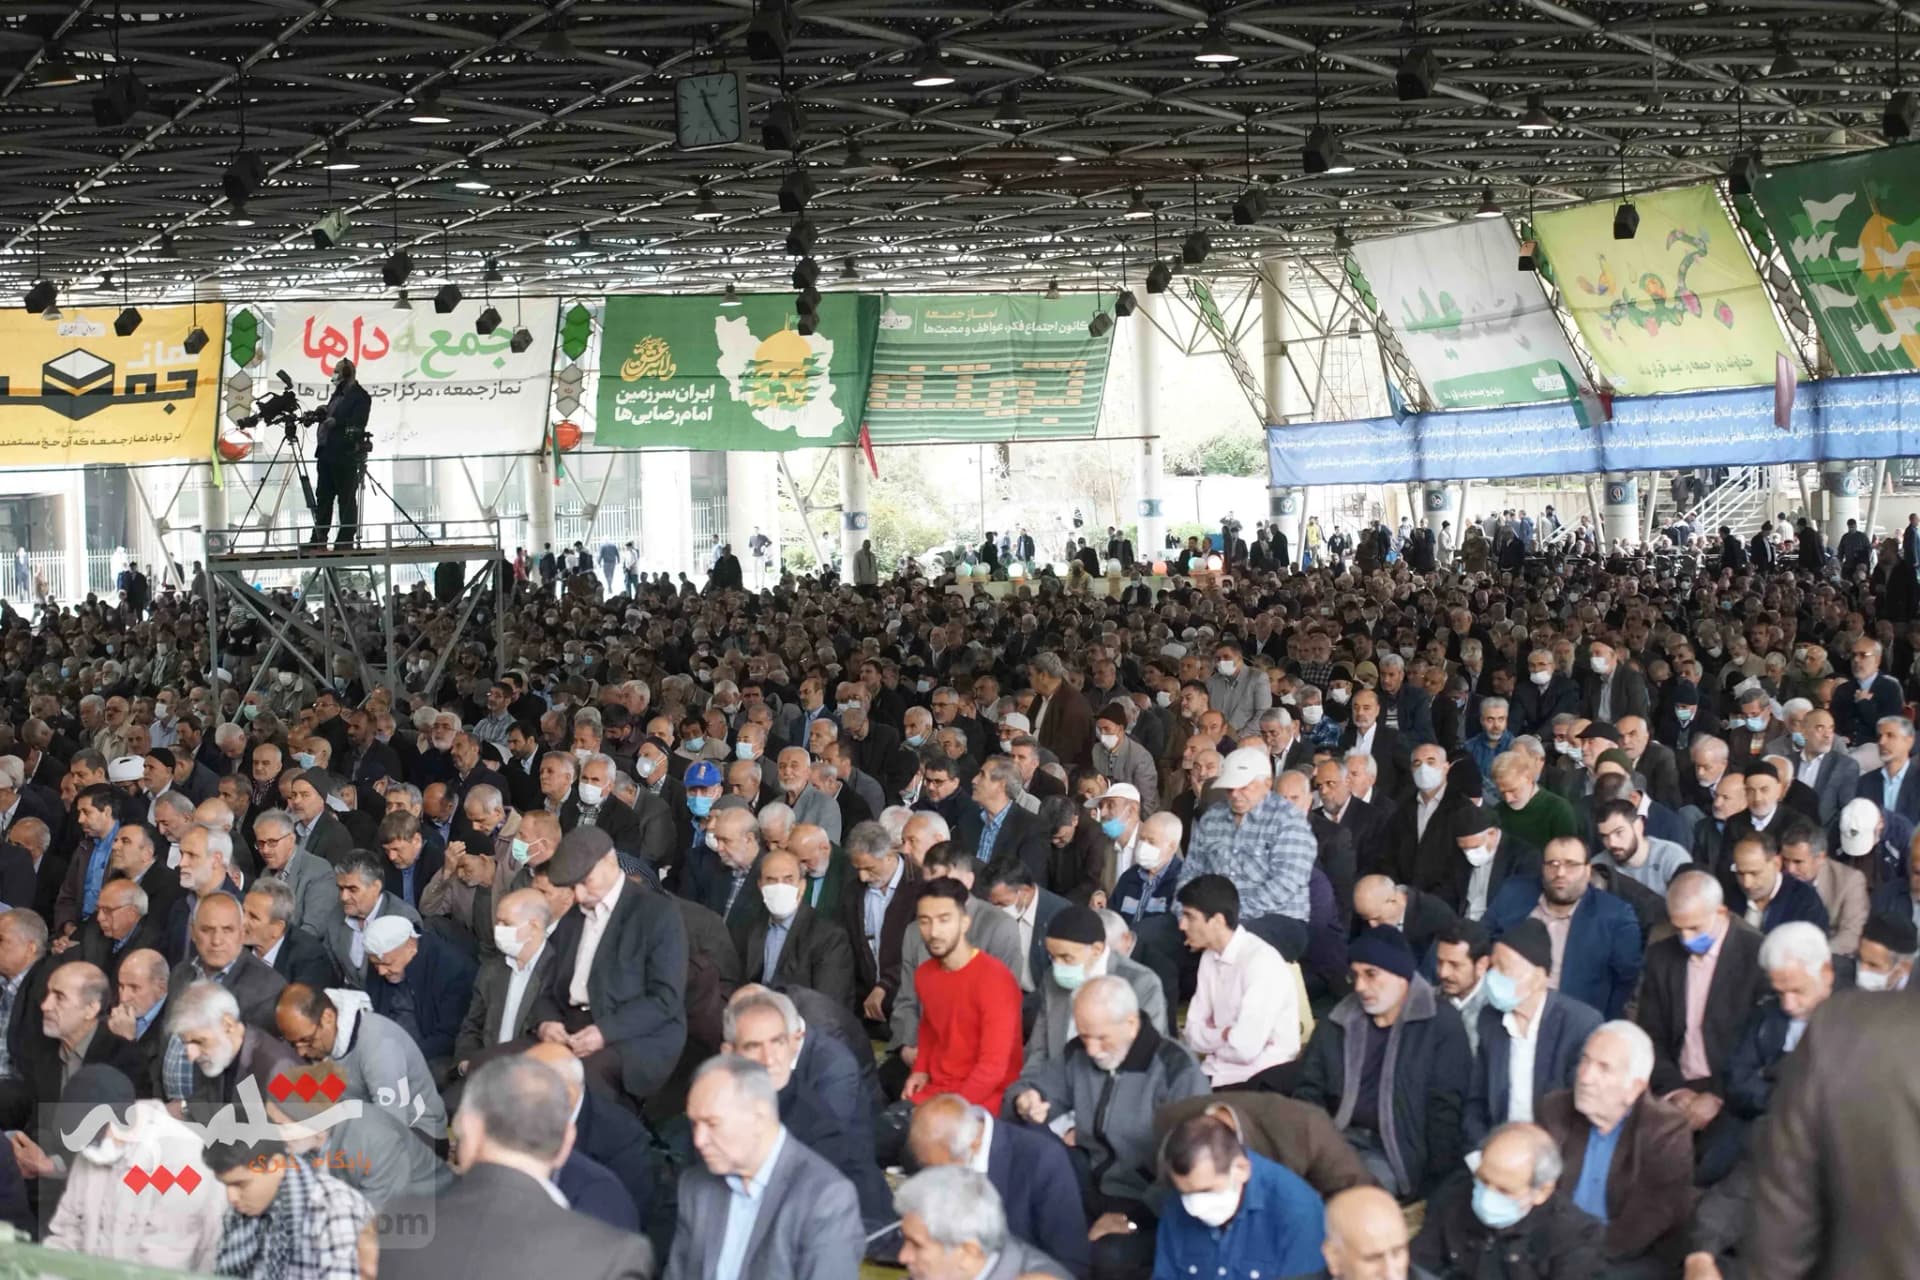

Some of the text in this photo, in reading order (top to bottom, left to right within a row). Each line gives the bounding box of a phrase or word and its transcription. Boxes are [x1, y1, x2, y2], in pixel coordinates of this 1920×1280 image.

[398, 382, 433, 402] مرکز
[489, 380, 522, 400] نماز
[615, 384, 716, 405] ایران سرزمین
[678, 405, 713, 426] امام
[73, 437, 89, 446] که
[90, 437, 128, 448] جمعه
[128, 434, 149, 445] نماز
